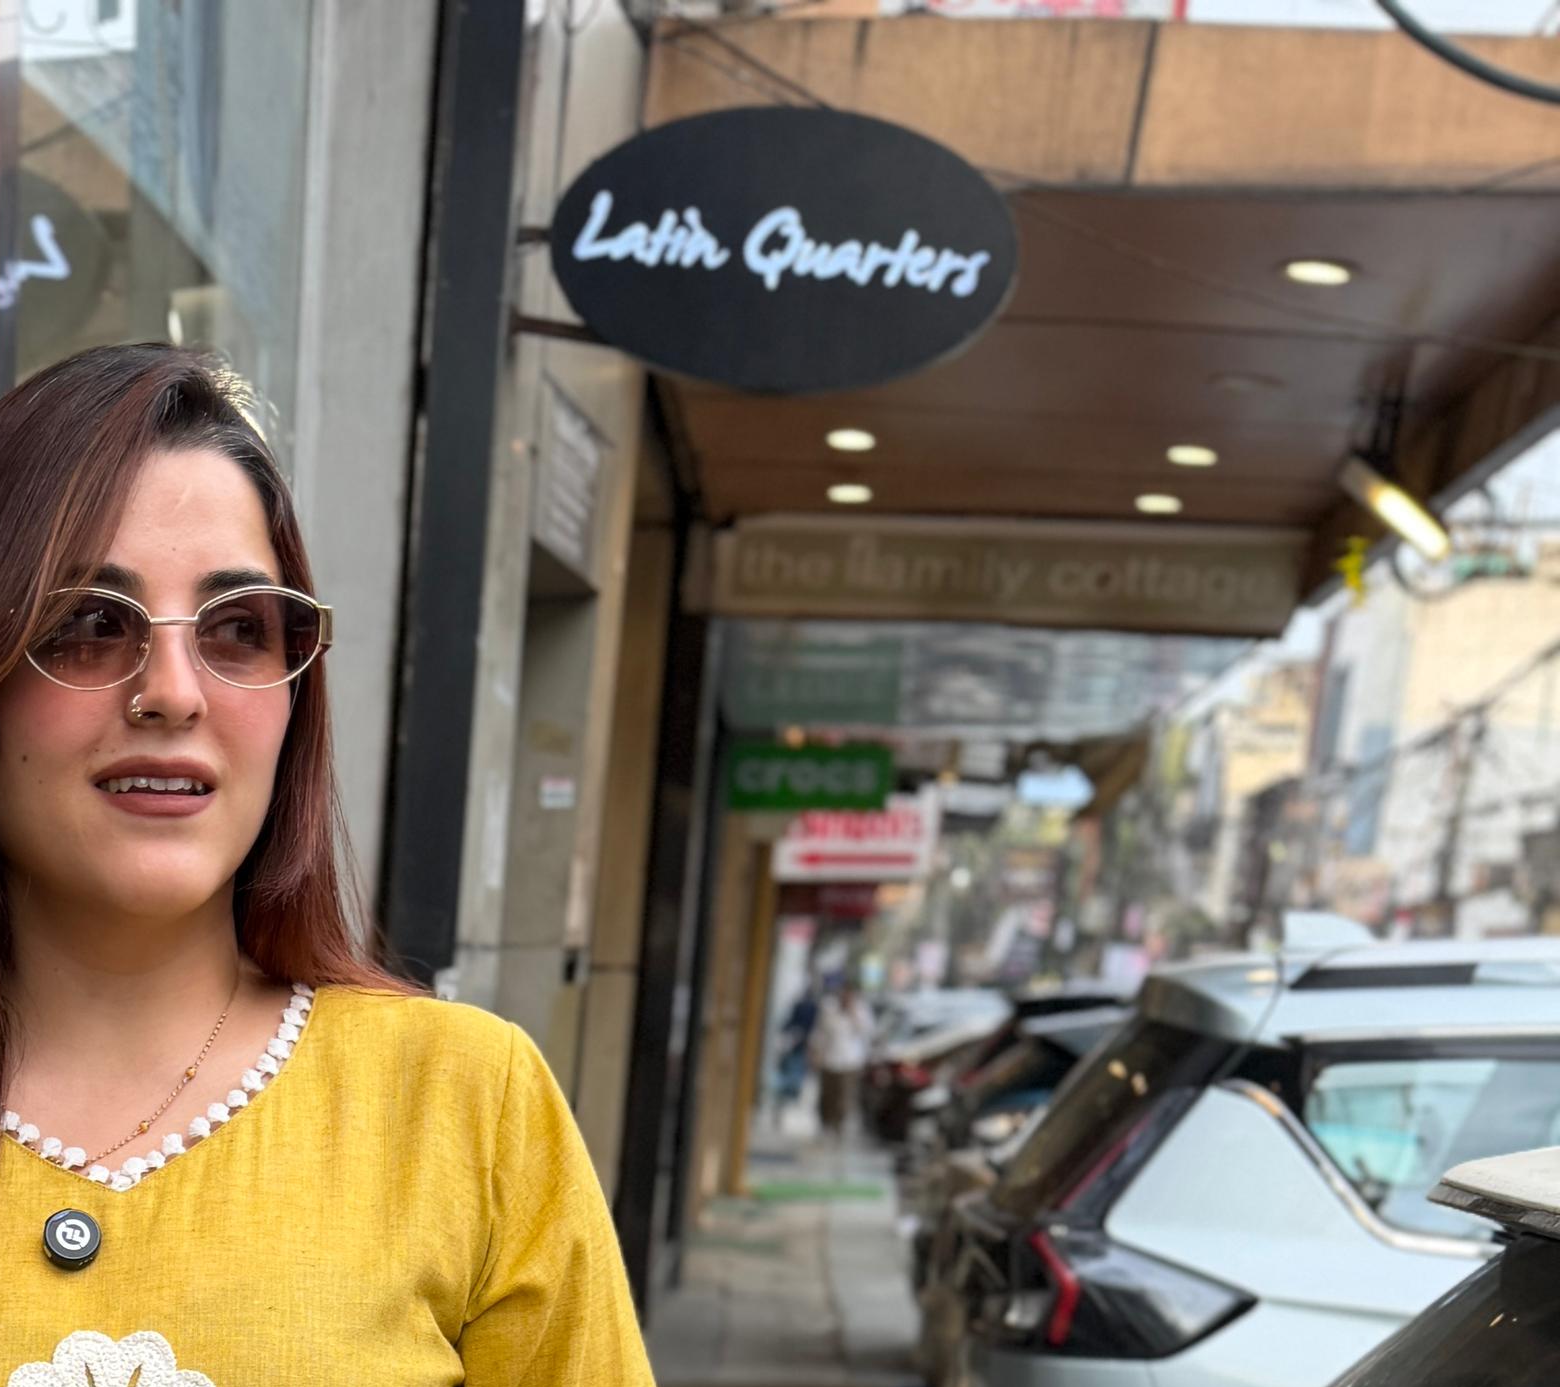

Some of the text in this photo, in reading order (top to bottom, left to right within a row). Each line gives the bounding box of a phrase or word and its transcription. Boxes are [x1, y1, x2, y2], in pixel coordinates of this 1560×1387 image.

[573, 189, 991, 297] Latin Quarters
[740, 540, 833, 588] the
[843, 533, 1031, 602] family
